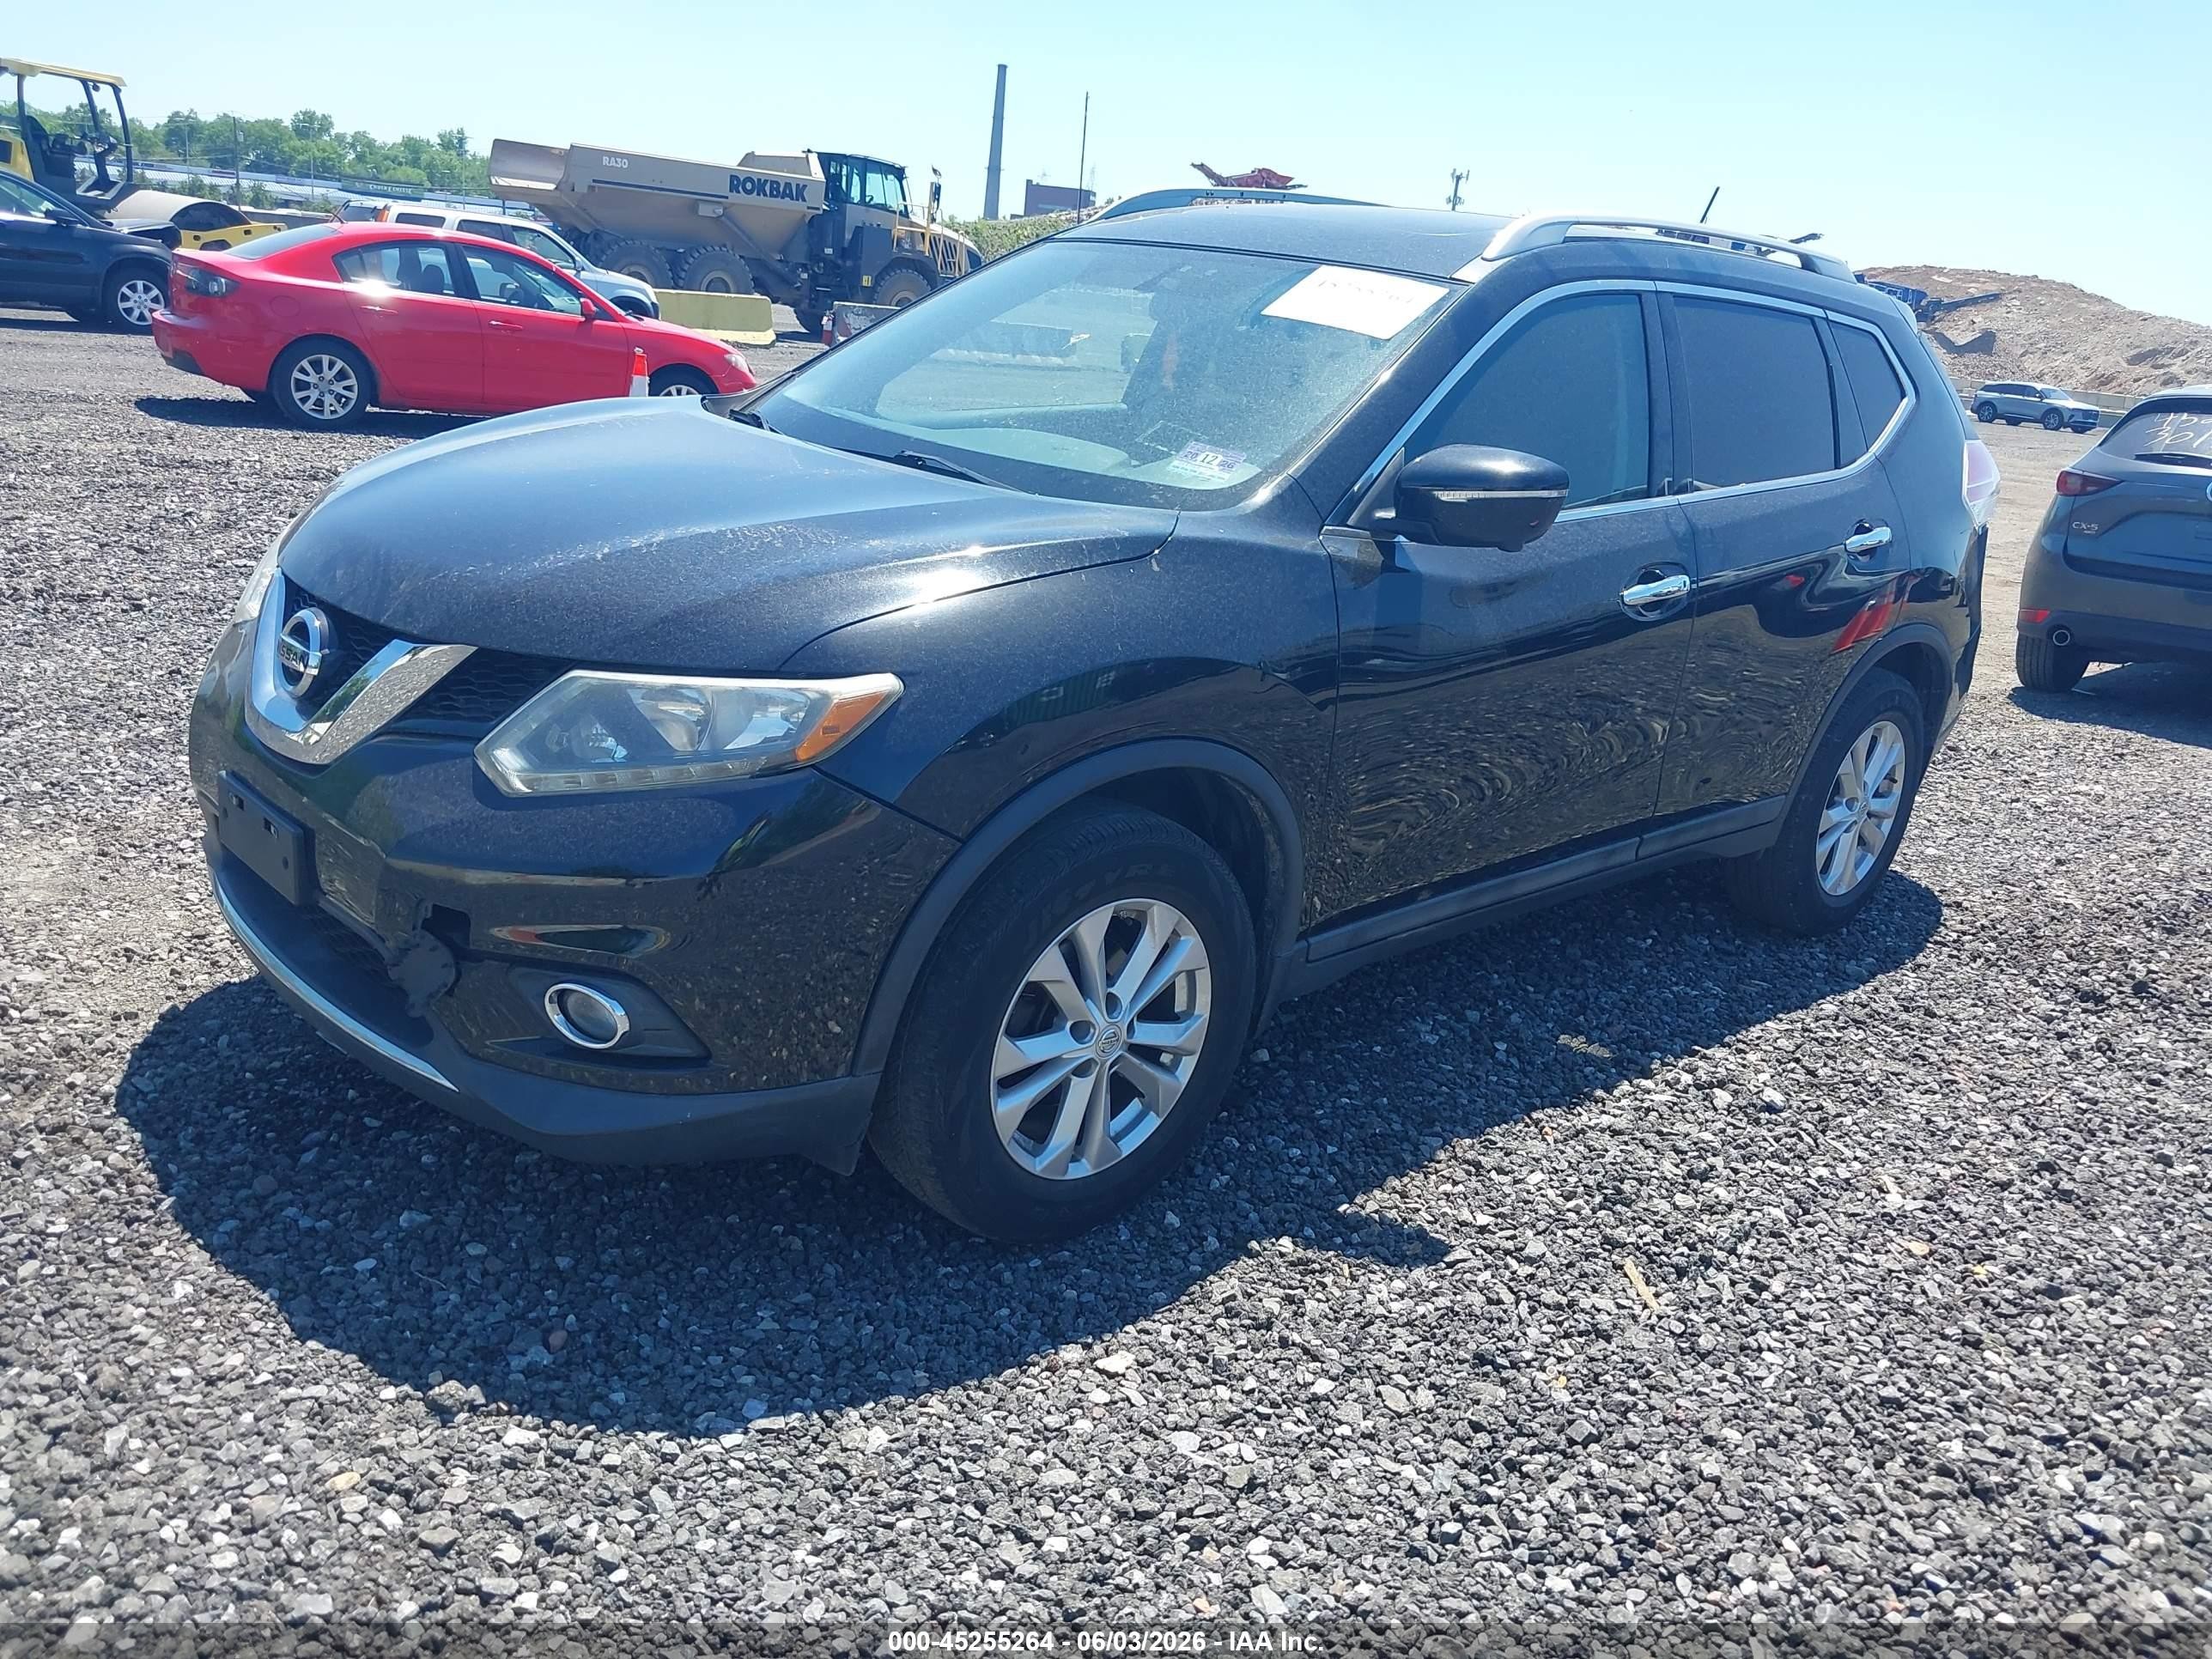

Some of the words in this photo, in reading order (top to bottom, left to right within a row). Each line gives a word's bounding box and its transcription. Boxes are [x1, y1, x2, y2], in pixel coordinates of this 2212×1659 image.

[602, 155, 629, 168] RA30
[729, 174, 808, 203] ROKBAK
[1200, 453, 1218, 465] 12
